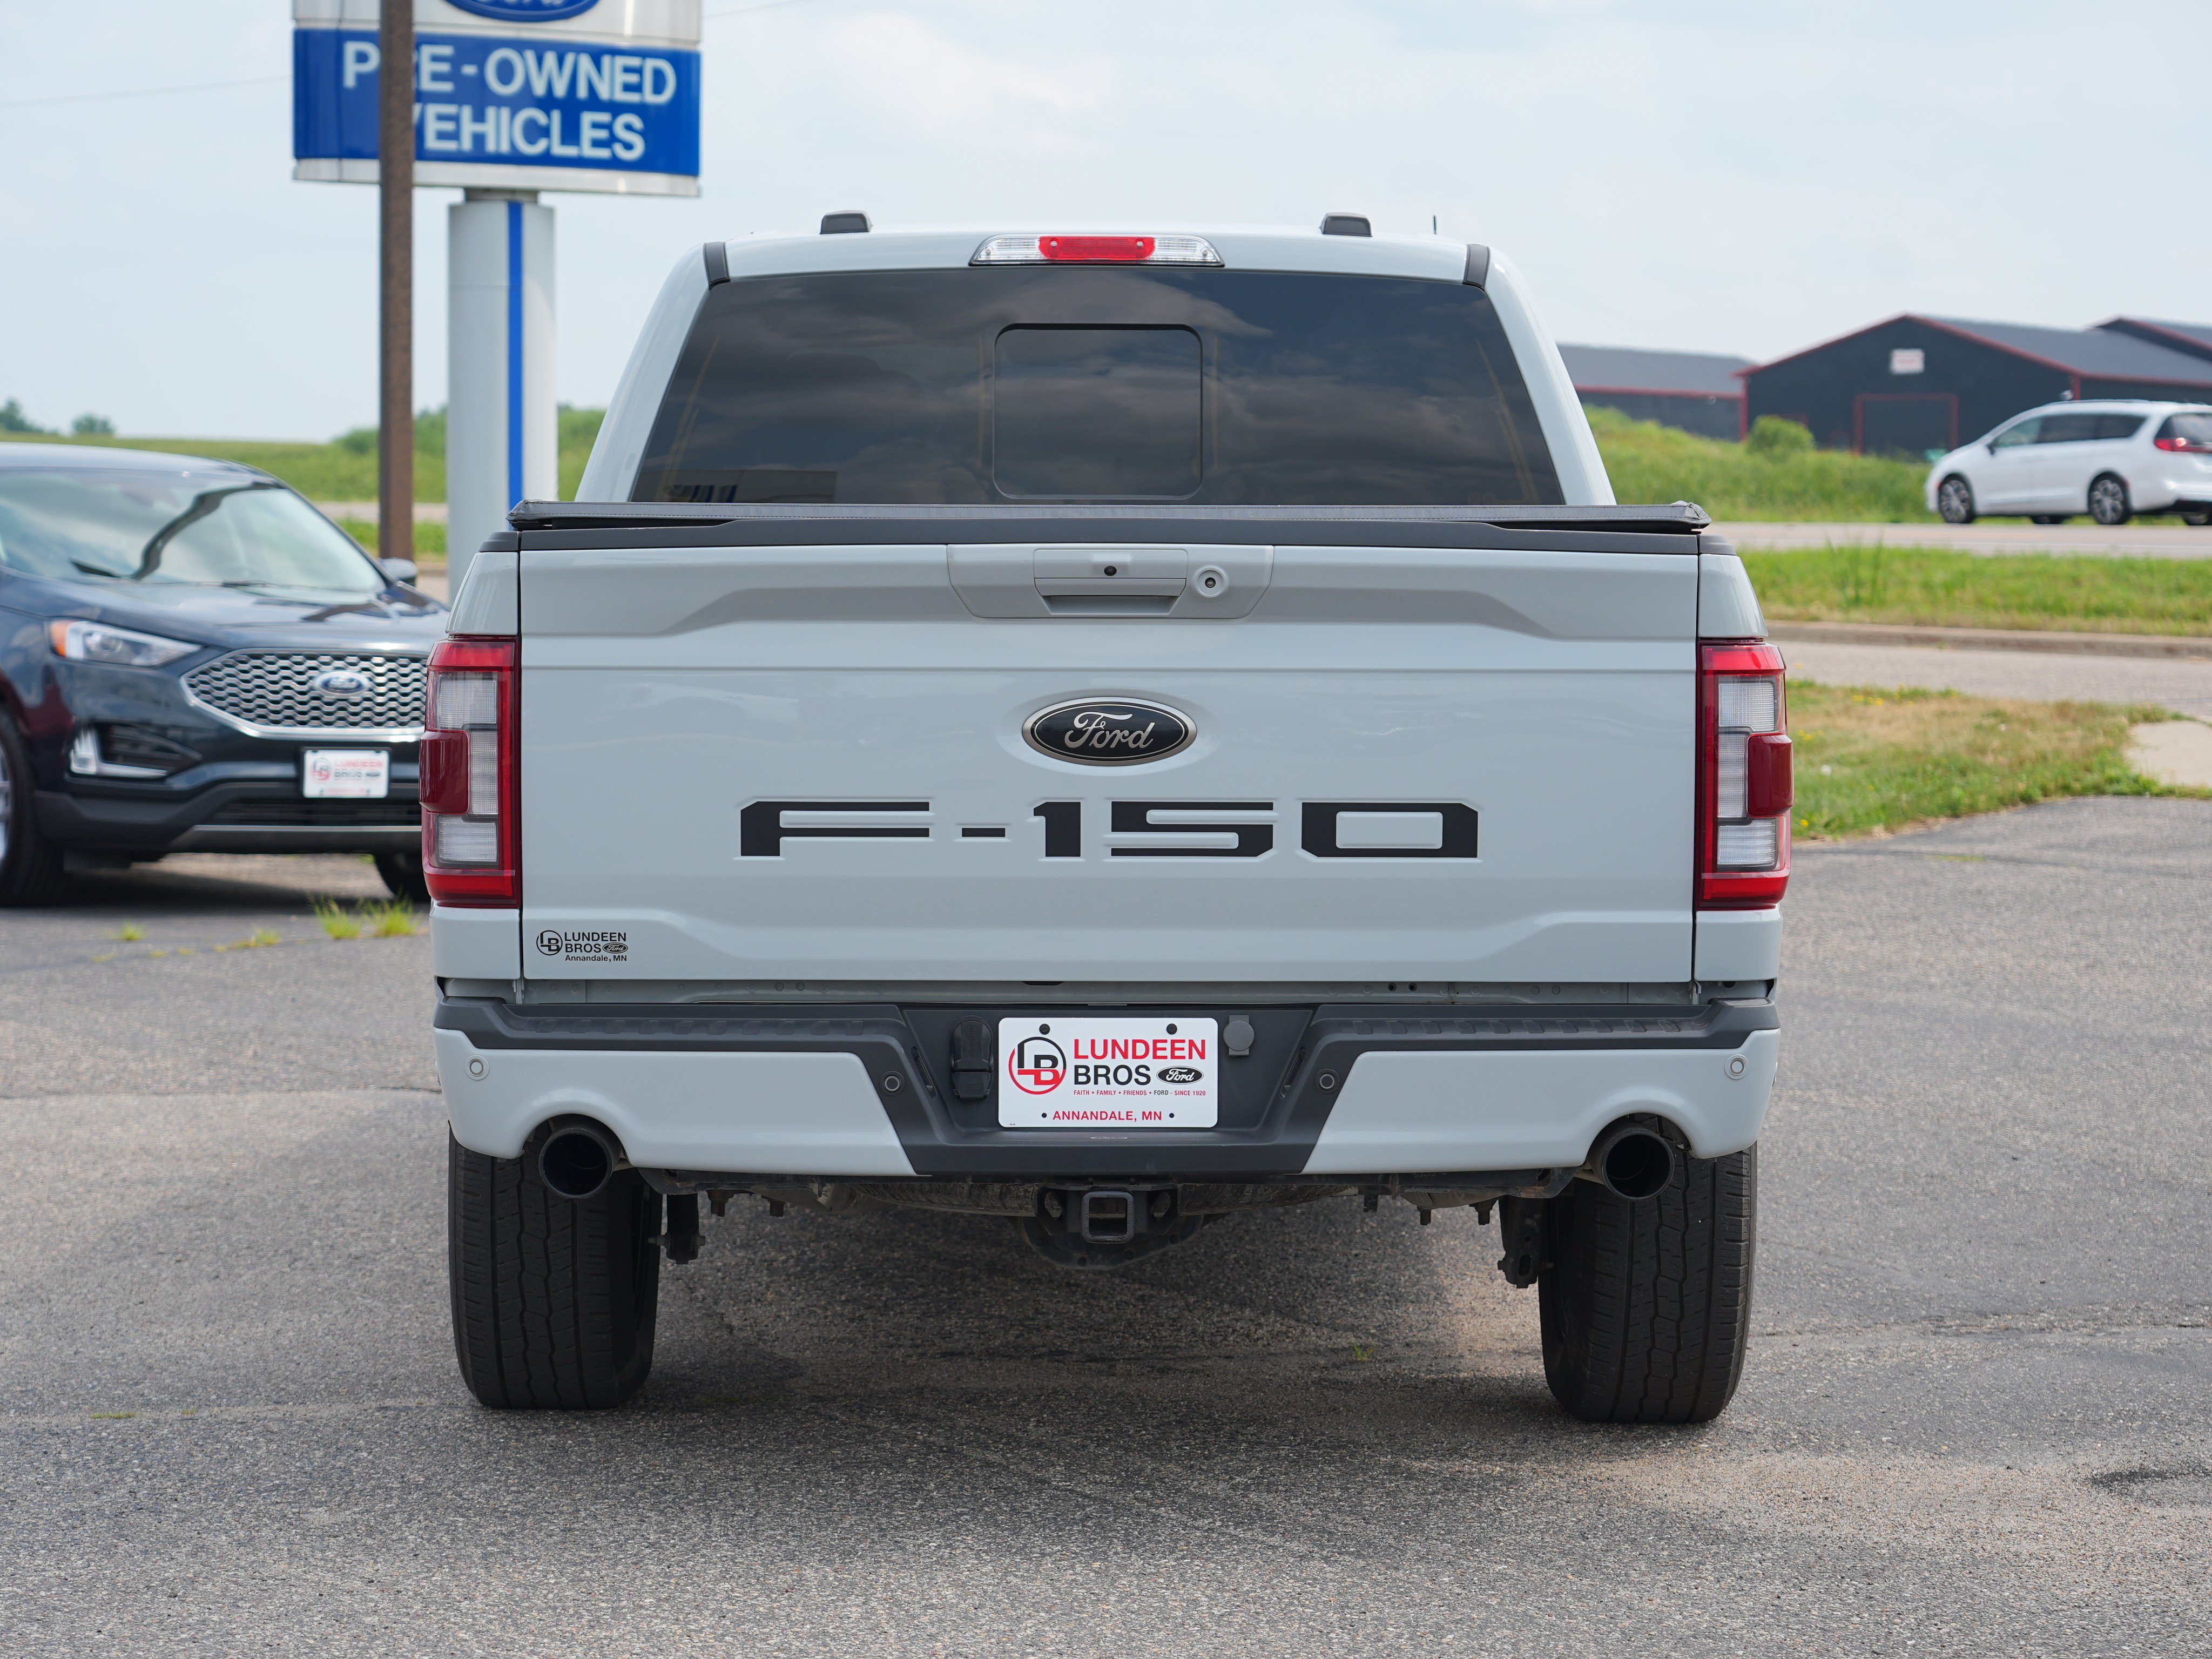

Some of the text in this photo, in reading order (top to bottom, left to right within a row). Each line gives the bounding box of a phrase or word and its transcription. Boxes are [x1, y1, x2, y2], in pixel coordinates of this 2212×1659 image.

[343, 41, 677, 106] PE-OWNED
[1064, 711, 1156, 748] Ford
[740, 801, 1479, 858] F-150
[564, 932, 626, 942] LUNDEEN
[565, 943, 602, 953] BROS
[565, 954, 611, 963] Annandale,
[1074, 1039, 1206, 1060] LUNDEEN
[1074, 1064, 1151, 1085] BROS
[1053, 1110, 1162, 1122] ANNANDALE, MN
